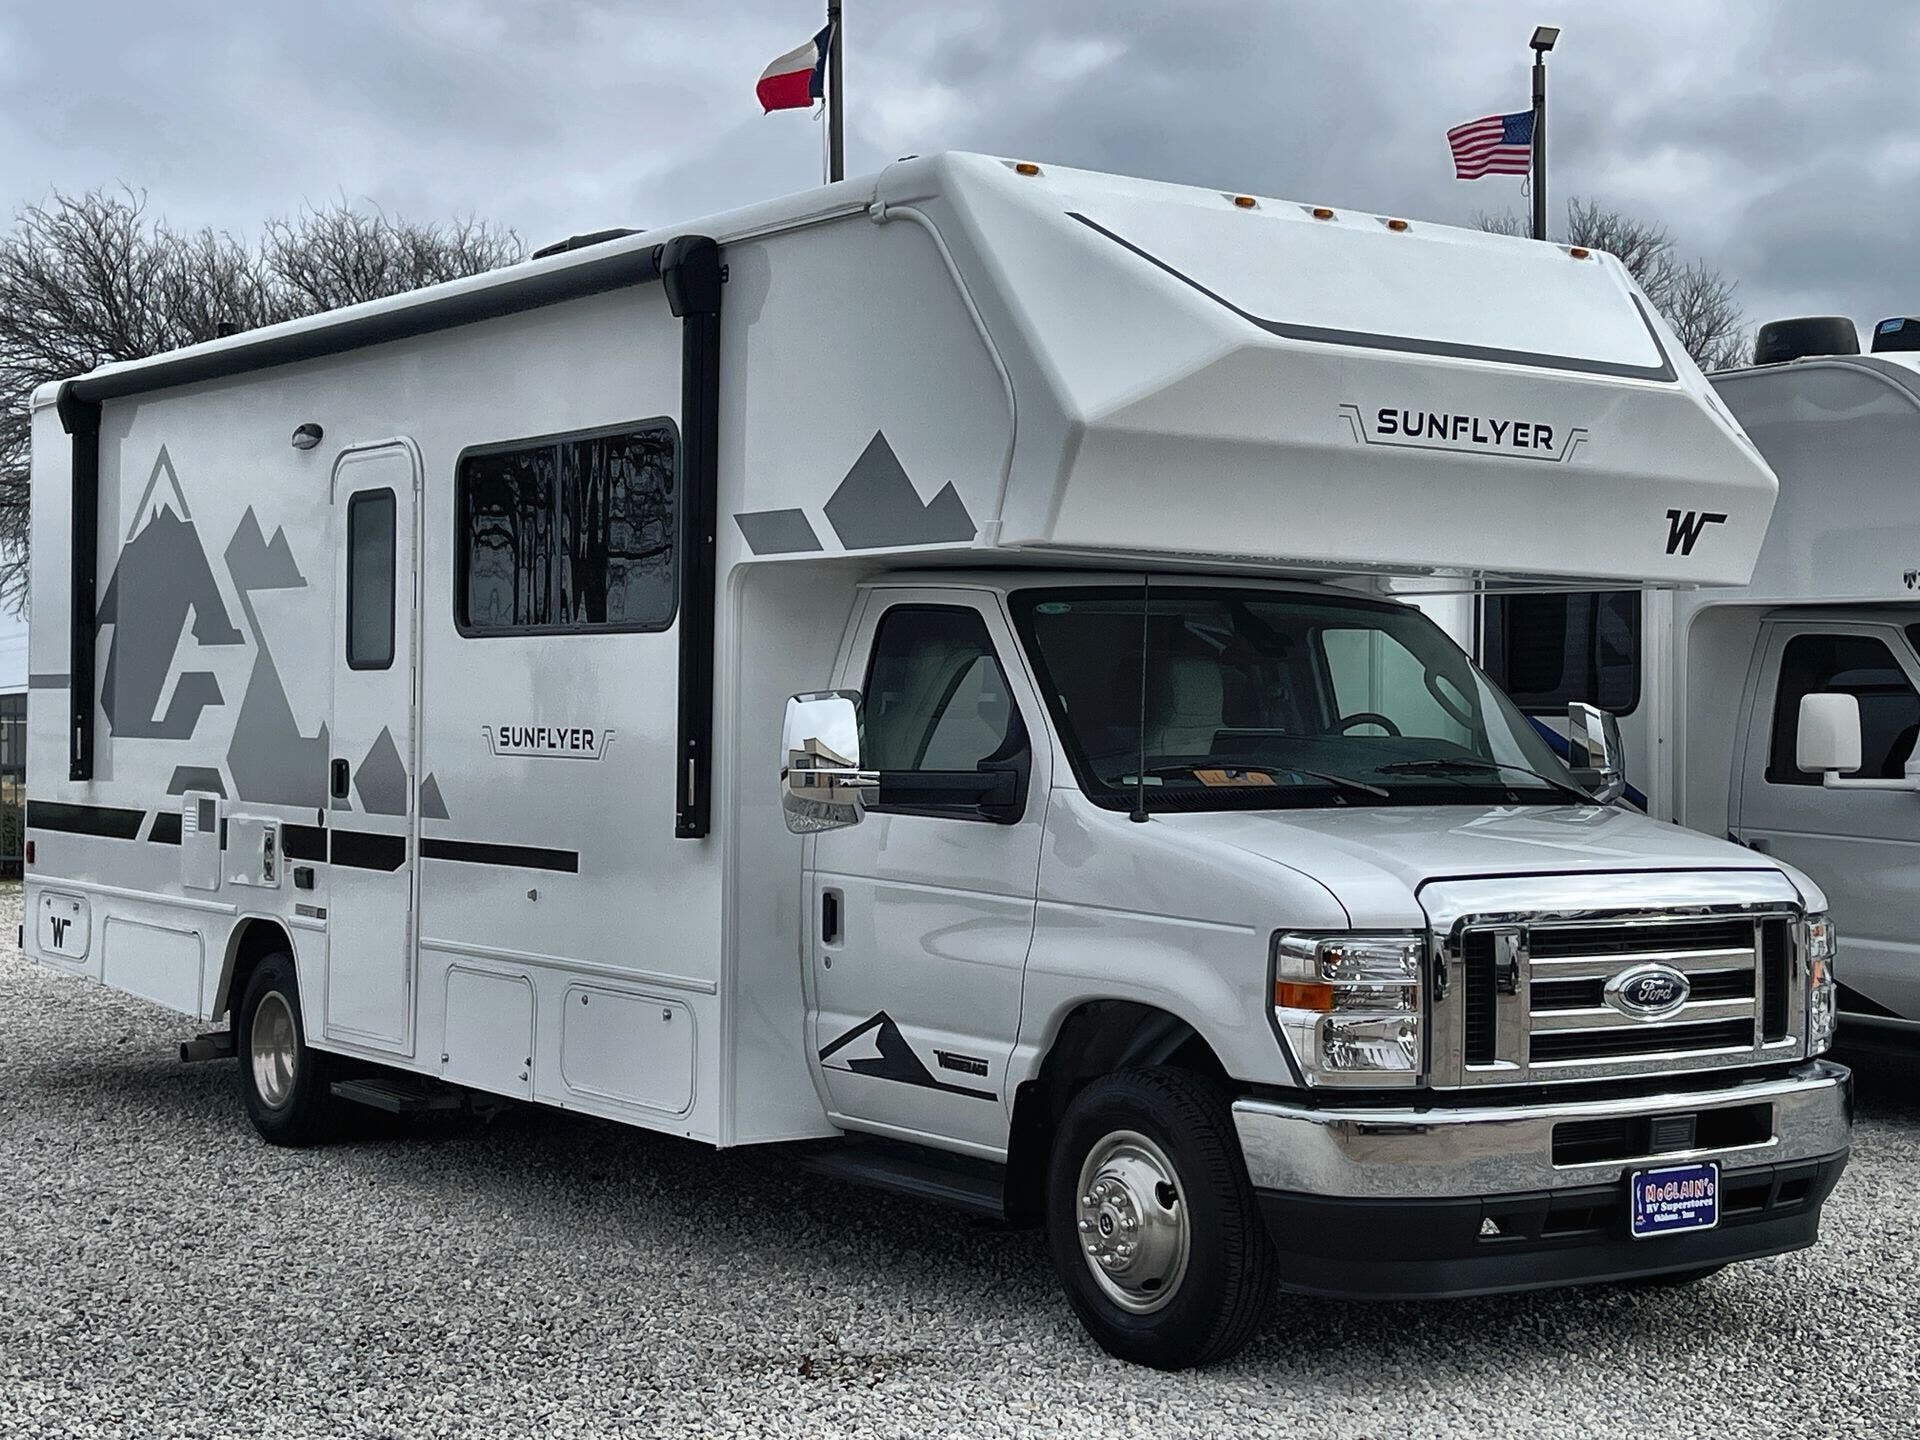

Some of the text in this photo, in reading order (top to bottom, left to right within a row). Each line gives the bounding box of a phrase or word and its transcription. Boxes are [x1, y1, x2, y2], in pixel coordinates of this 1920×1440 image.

[1376, 408, 1554, 451] SUNFLYER
[499, 726, 595, 751] SUNFLYER
[1638, 979, 1674, 1001] Ford
[1646, 1198, 1713, 1214] RV Superstores
